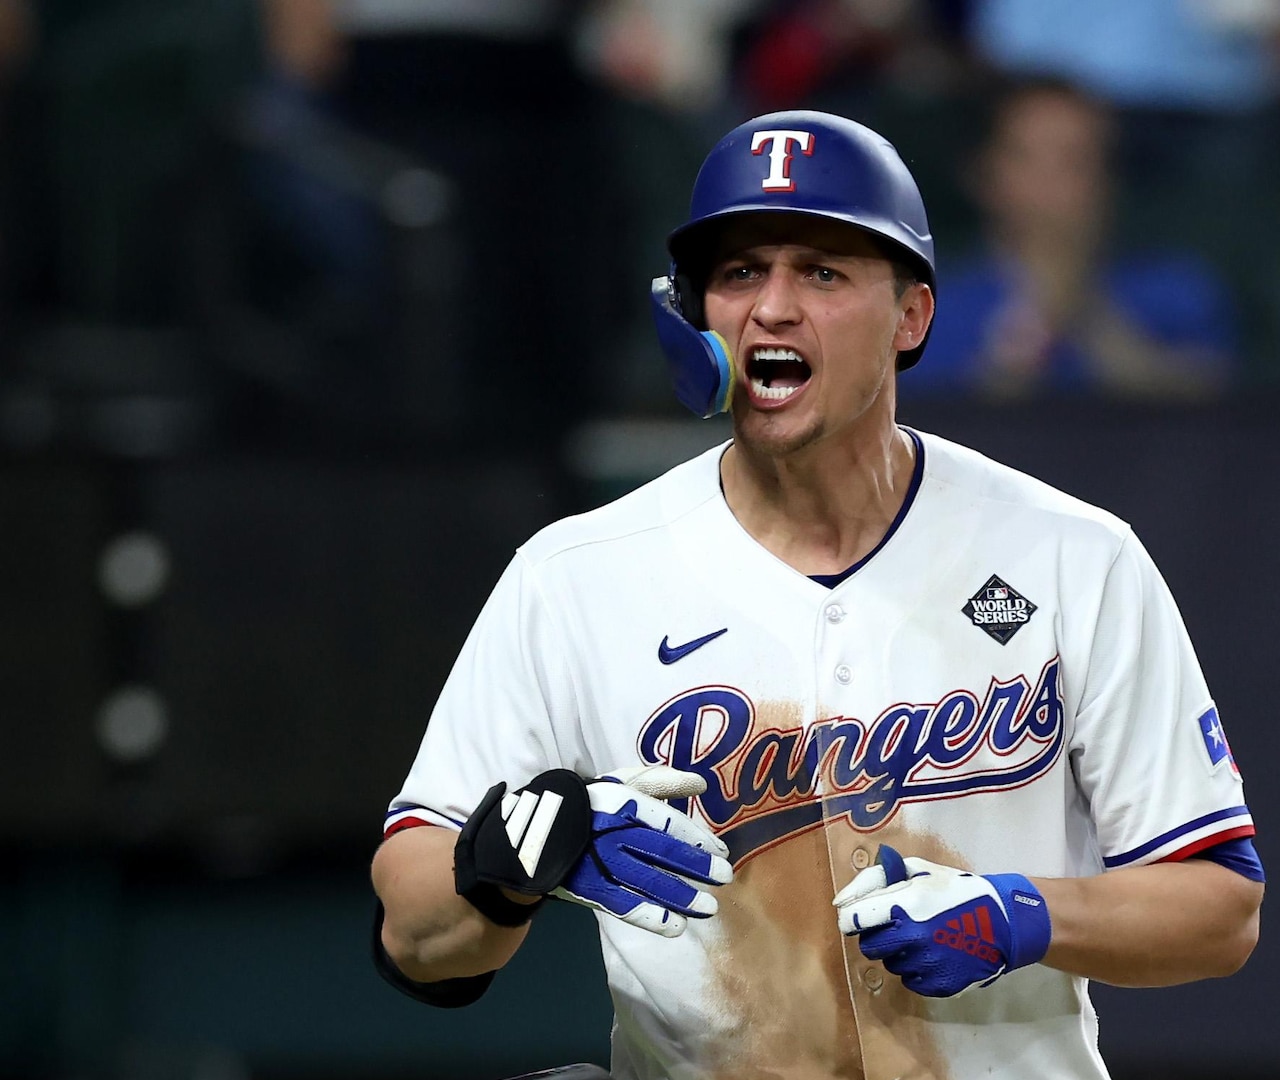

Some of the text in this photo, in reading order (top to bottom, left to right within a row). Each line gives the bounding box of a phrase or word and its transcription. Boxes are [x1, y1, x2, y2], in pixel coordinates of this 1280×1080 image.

[750, 129, 815, 192] T
[971, 598, 1026, 612] WORLD
[973, 609, 1028, 624] SERIES
[636, 655, 1066, 834] Rangers
[933, 929, 1001, 964] adidas
